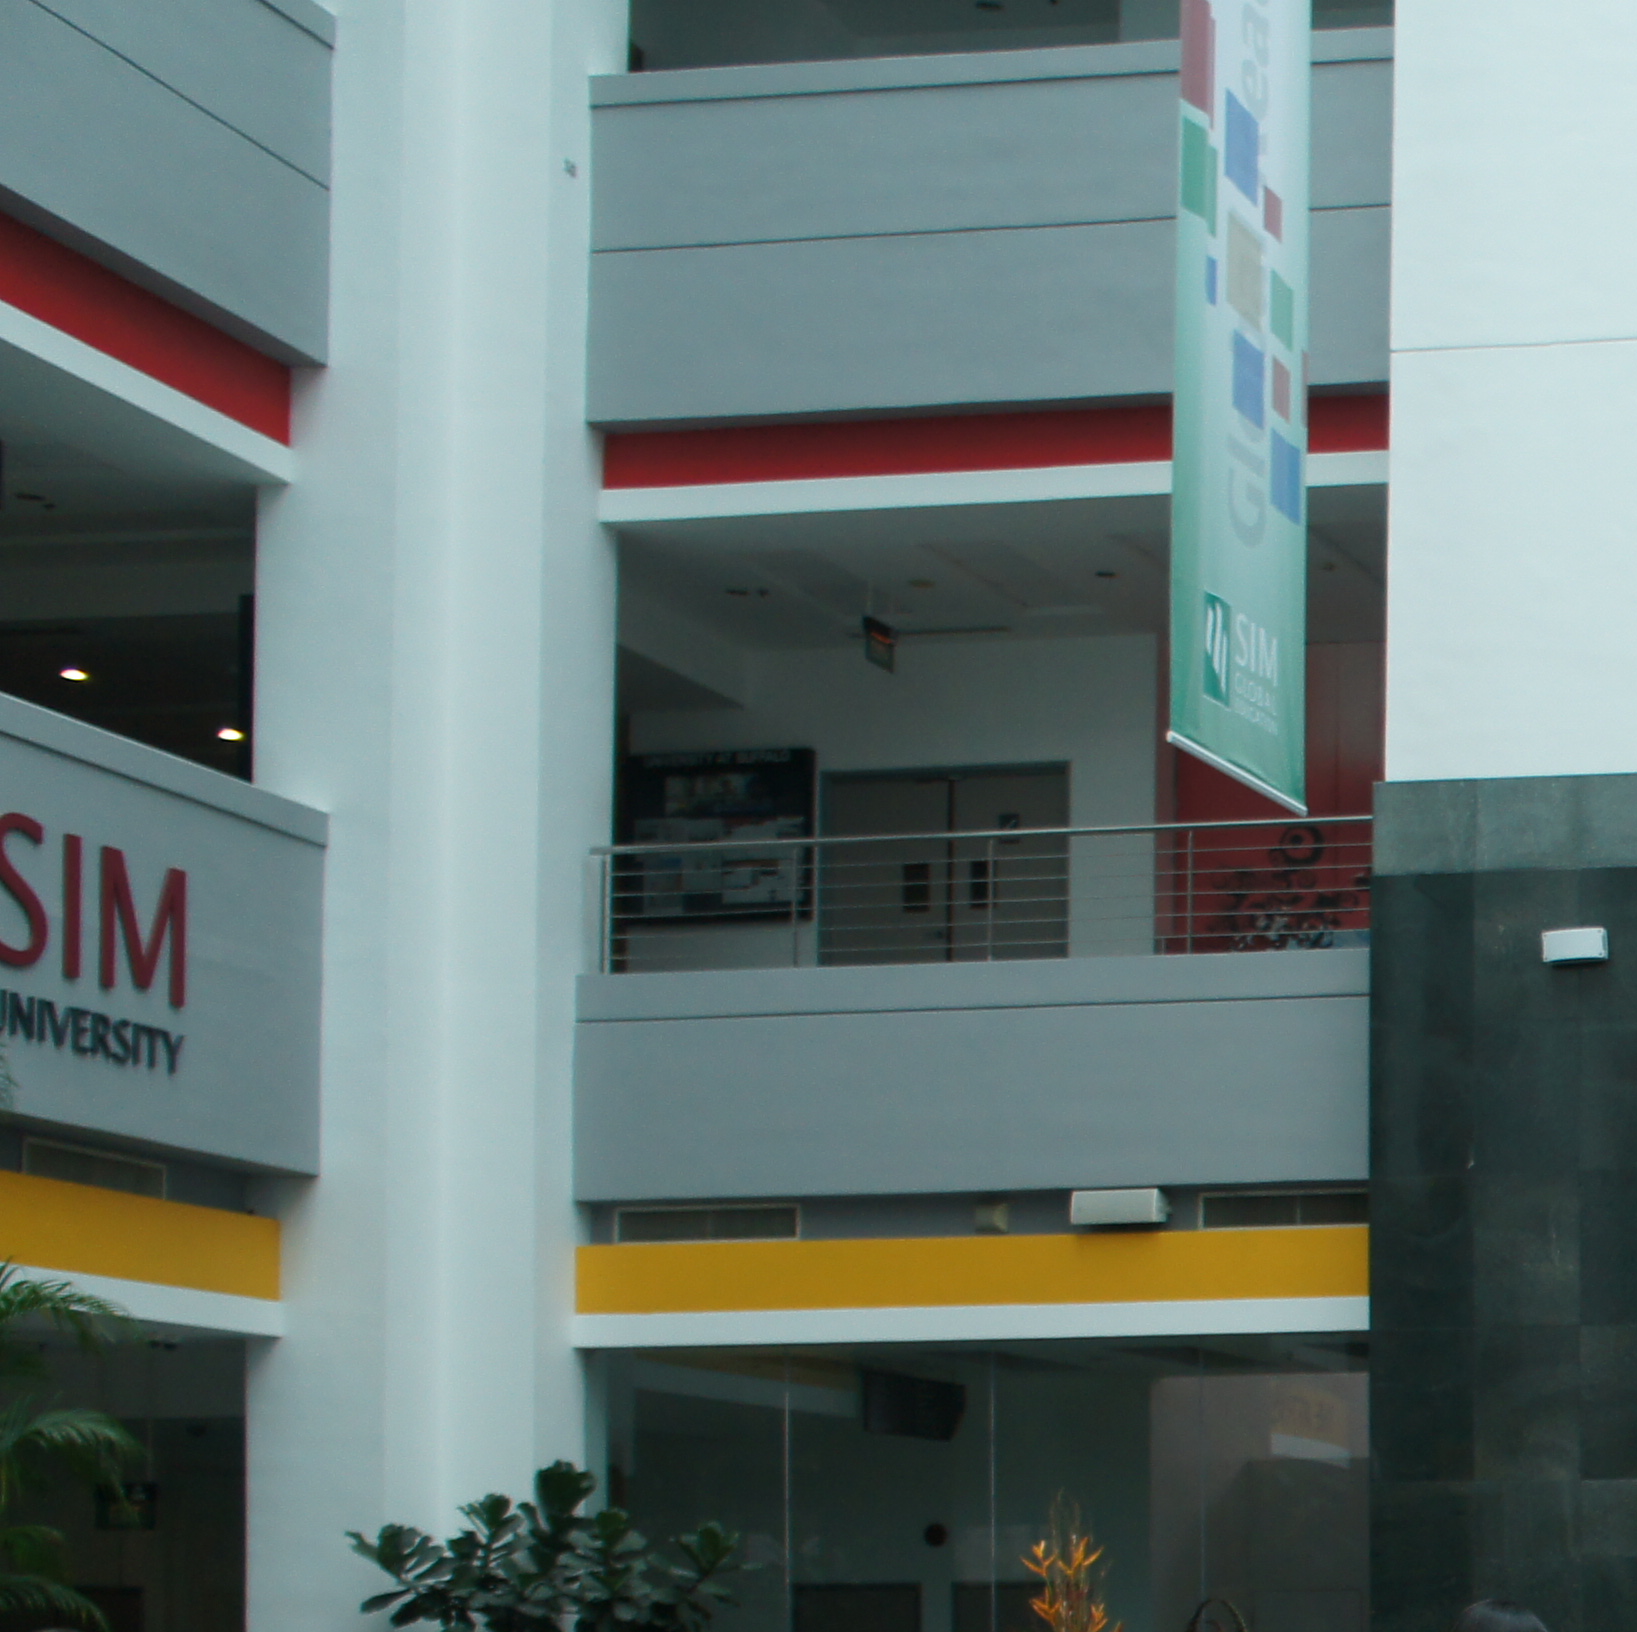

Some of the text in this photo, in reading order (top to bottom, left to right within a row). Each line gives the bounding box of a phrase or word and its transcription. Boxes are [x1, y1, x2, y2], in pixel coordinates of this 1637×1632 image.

[1236, 613, 1278, 686] SIM
[1235, 672, 1278, 716] GLOBAL
[0, 812, 188, 1009] SIM
